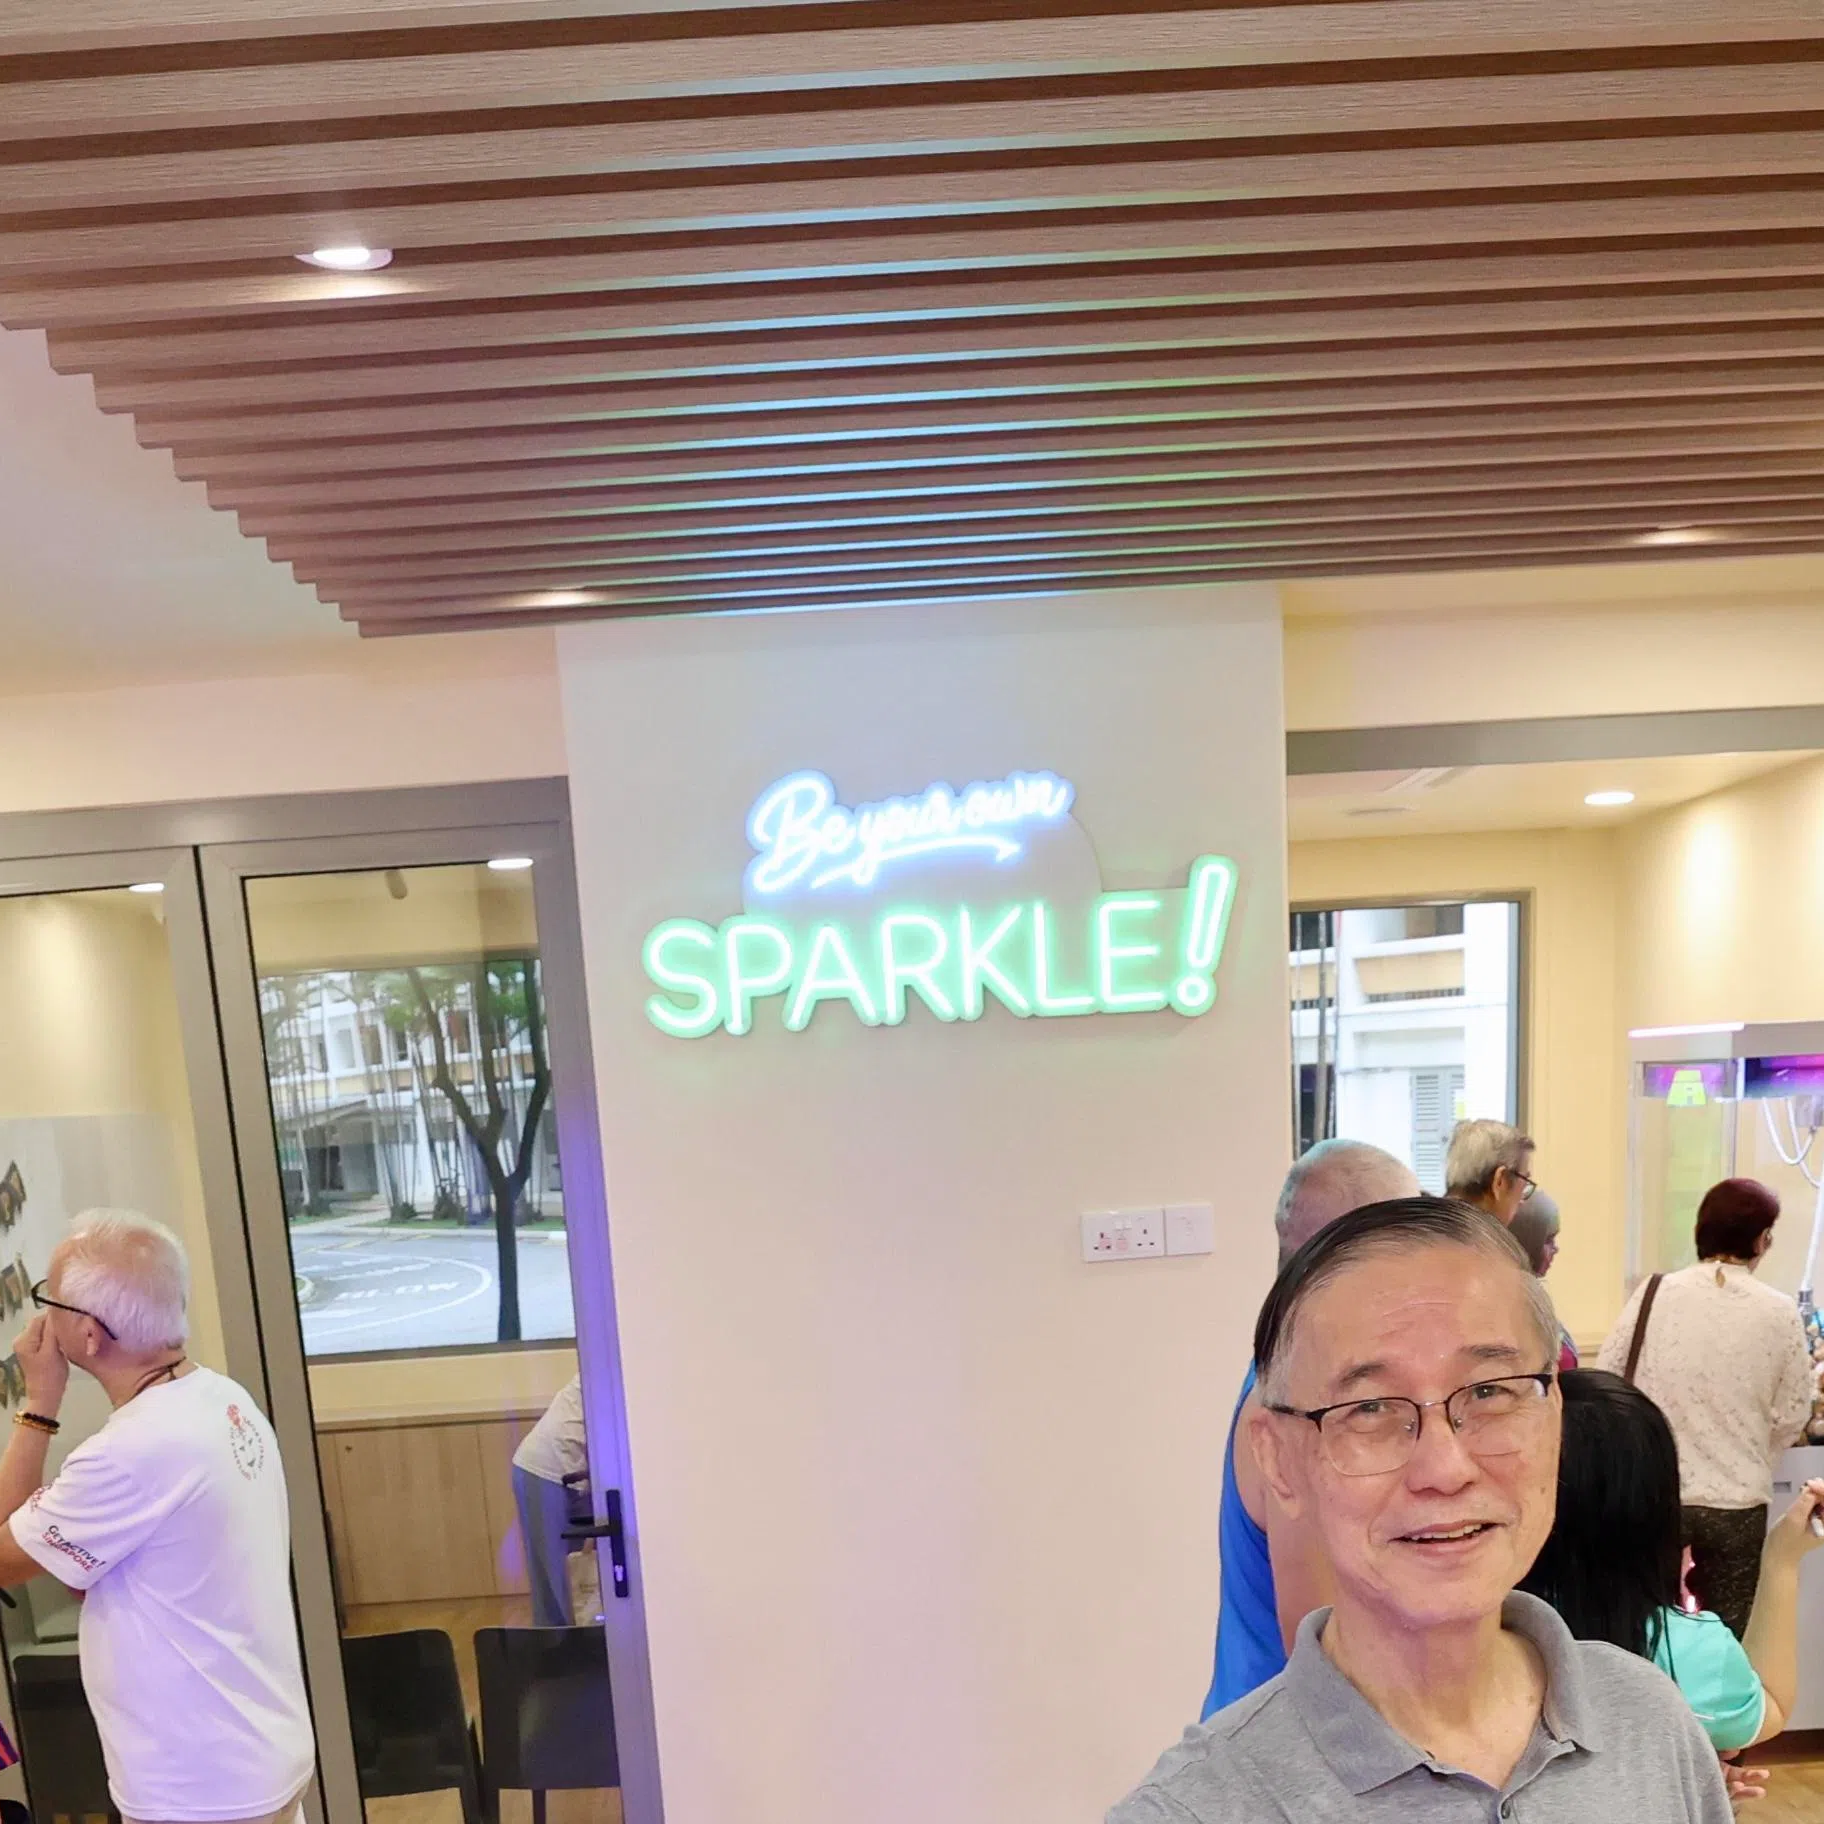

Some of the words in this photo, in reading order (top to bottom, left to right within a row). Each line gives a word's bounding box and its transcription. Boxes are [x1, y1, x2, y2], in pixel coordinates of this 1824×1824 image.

[752, 776, 856, 893] Be
[858, 785, 964, 886] your
[964, 776, 1068, 828] own
[643, 857, 1236, 1037] SPARKLE!
